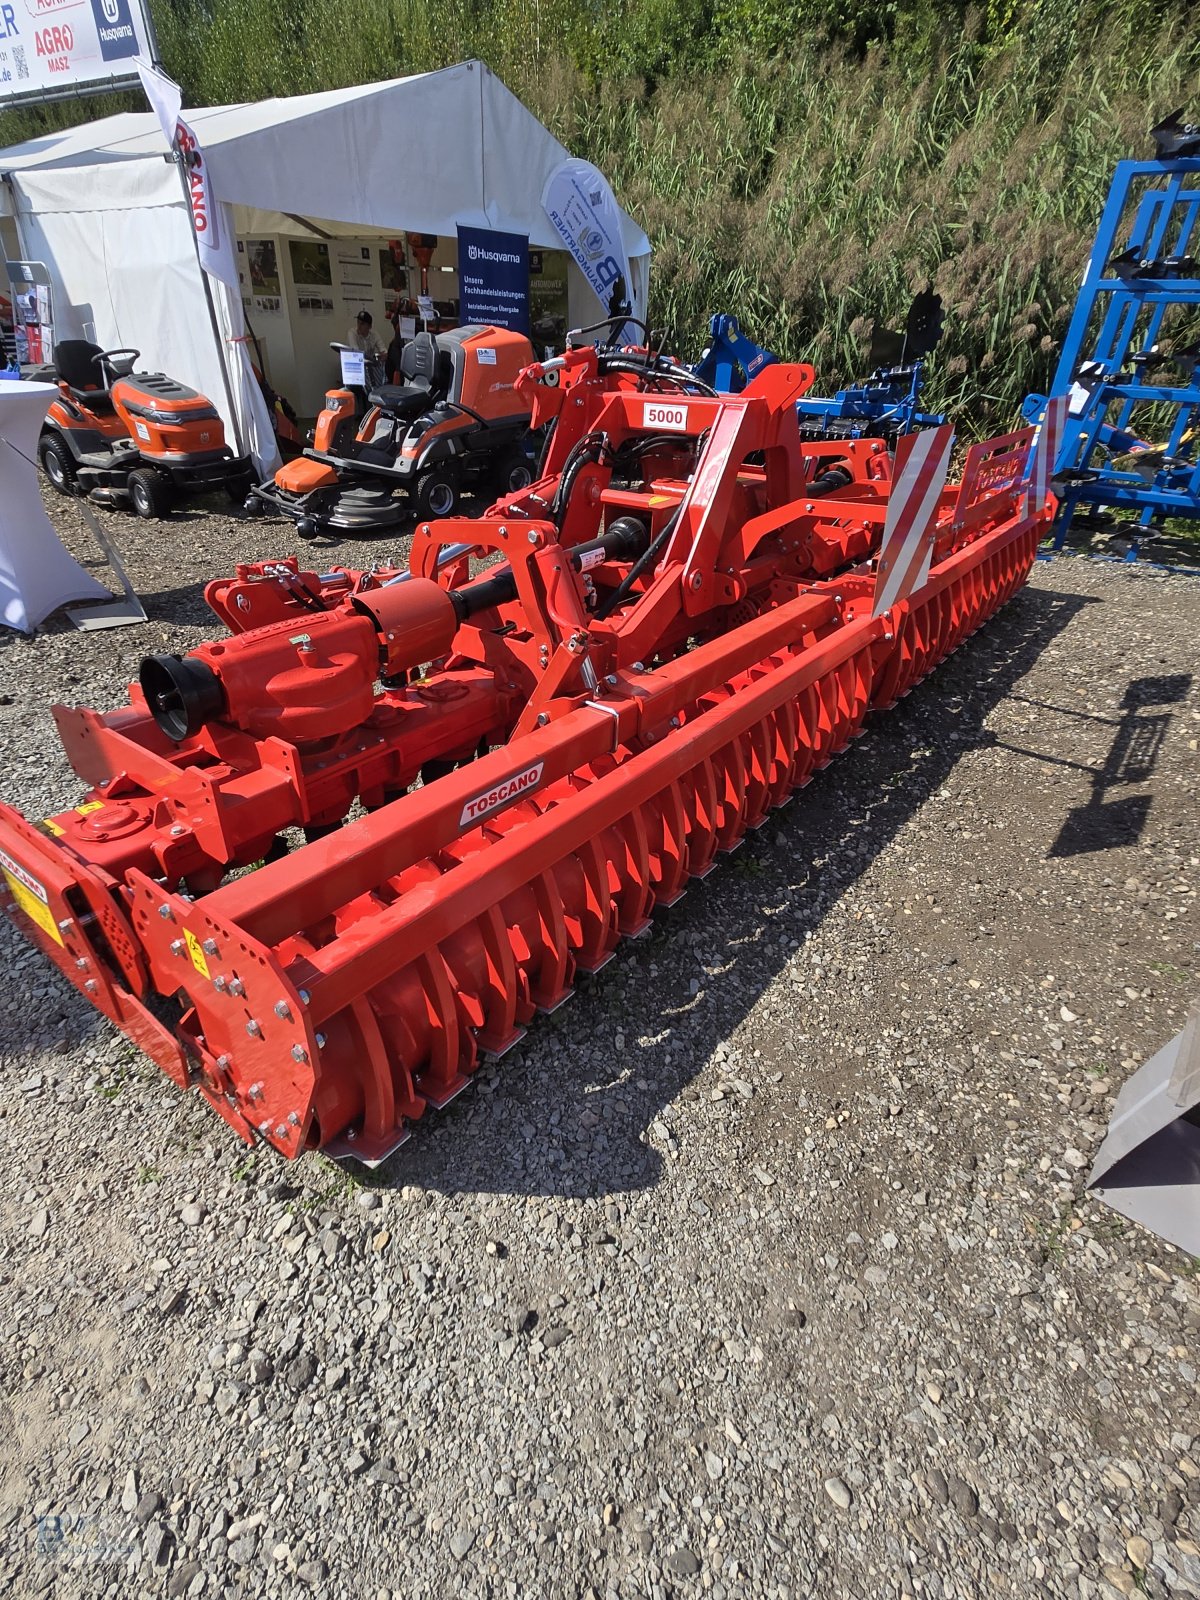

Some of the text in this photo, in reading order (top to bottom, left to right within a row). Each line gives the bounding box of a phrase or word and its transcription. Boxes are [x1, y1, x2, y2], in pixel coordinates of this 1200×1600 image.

[35, 24, 74, 57] AGRO
[99, 24, 134, 41] Husqvarna
[47, 56, 71, 73] MASZ
[477, 247, 521, 264] Husqvarna
[463, 275, 484, 285] Unsere
[464, 286, 526, 300] Fachhandelsleistungen:
[648, 409, 683, 424] 5000
[466, 769, 538, 818] TOSCANO
